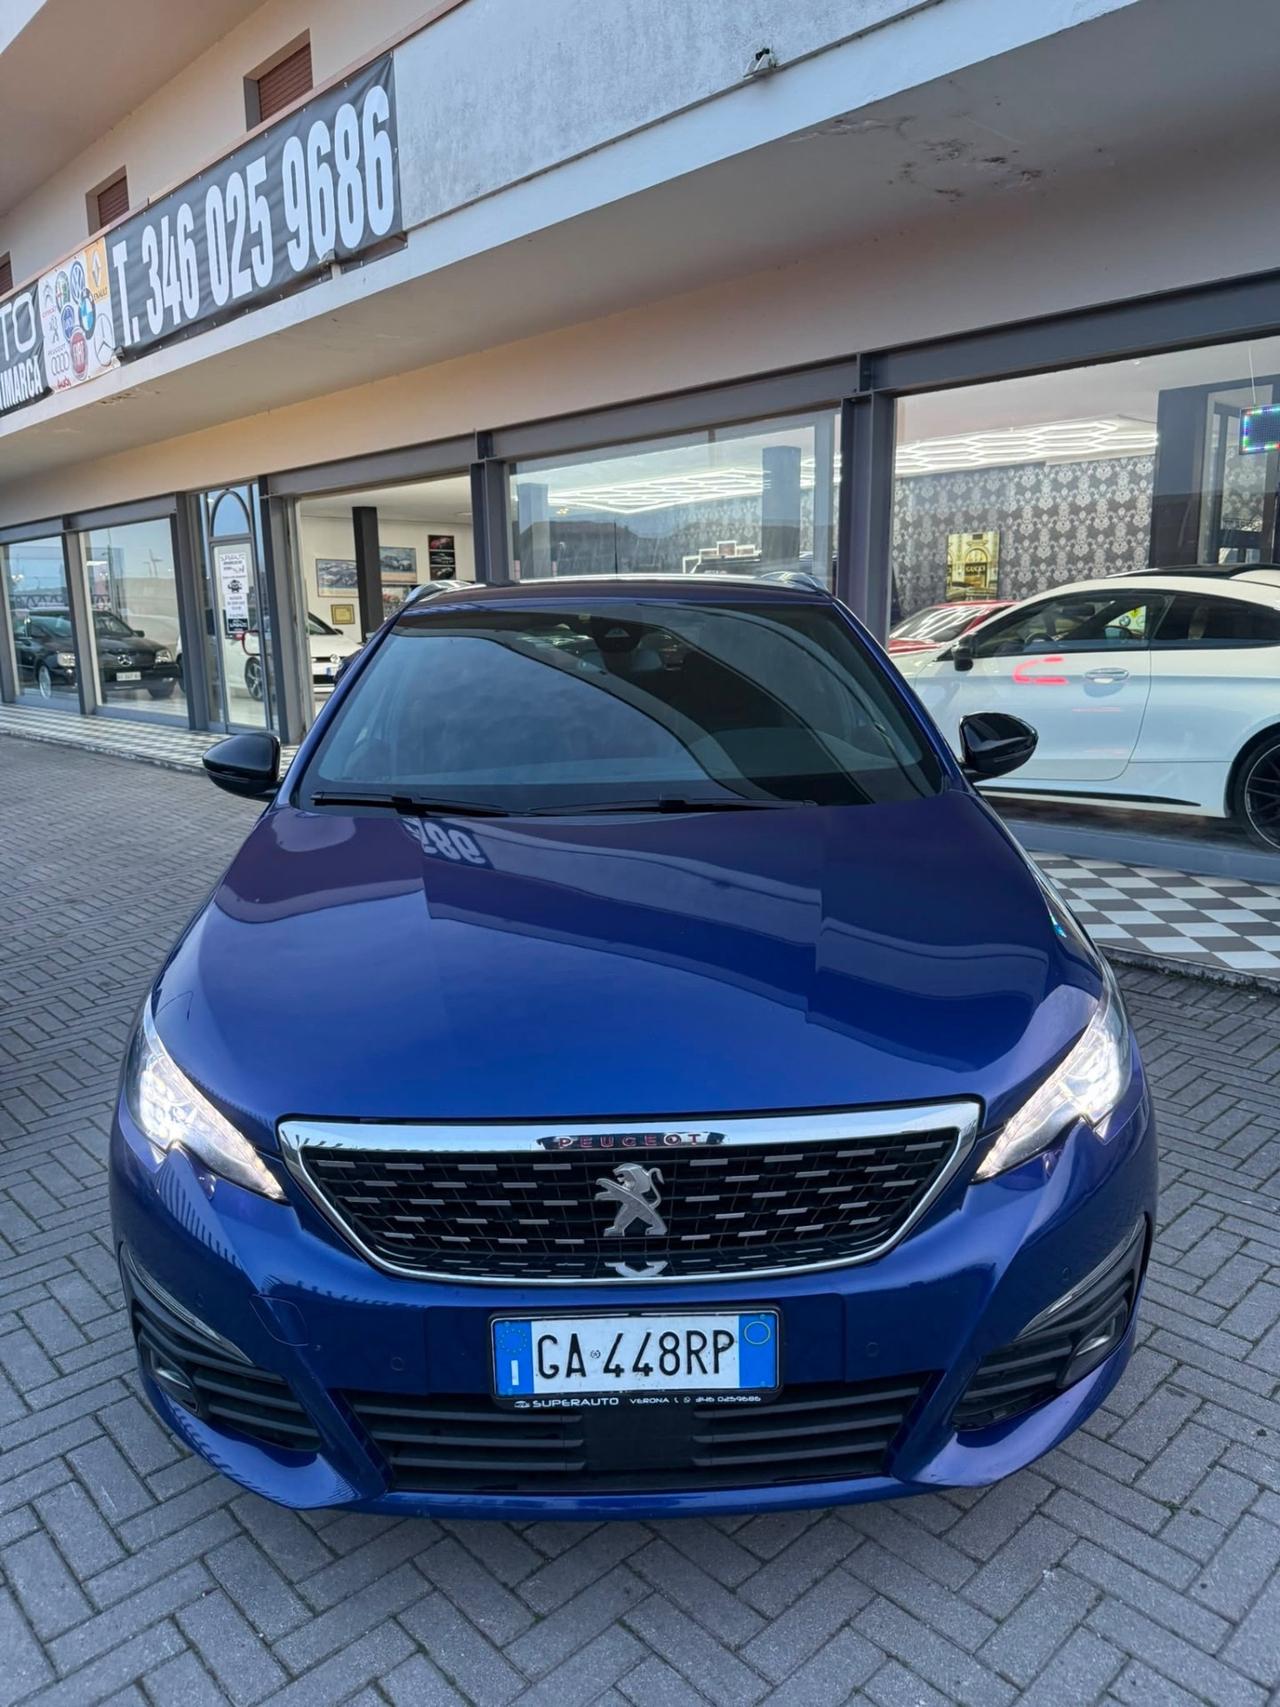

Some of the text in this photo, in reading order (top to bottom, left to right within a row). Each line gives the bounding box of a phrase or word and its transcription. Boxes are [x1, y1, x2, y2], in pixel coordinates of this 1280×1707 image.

[113, 85, 394, 345] T. 346 025 9686
[0, 355, 43, 410] IMARCA
[556, 1133, 702, 1149] PEUGEOT
[532, 1397, 619, 1408] SUPERAUTO
